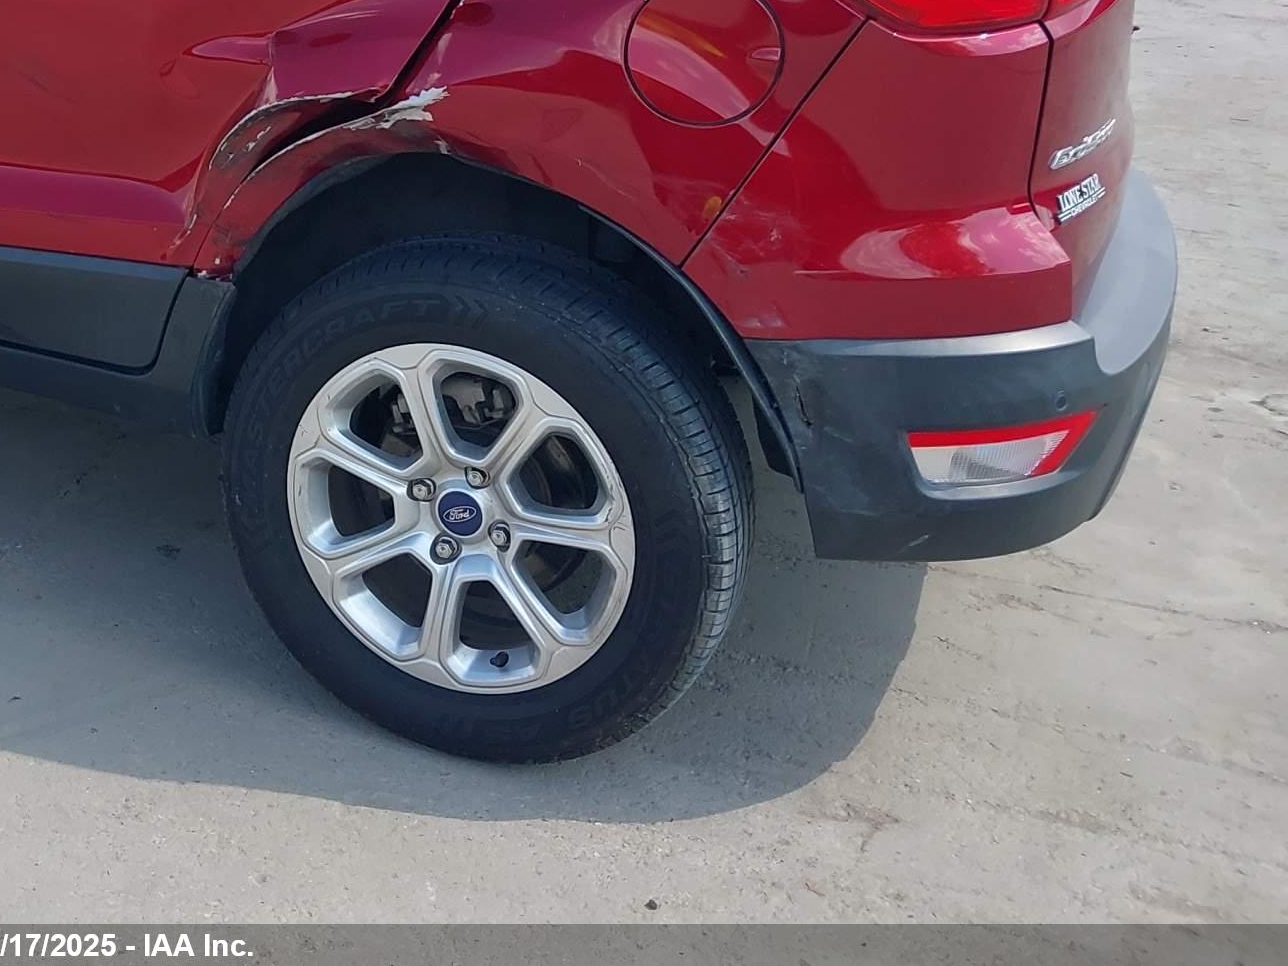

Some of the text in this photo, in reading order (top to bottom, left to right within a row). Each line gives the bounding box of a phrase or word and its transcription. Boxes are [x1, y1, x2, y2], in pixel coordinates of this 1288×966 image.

[1056, 173, 1102, 213] LONE STAR
[448, 508, 470, 521] Ford
